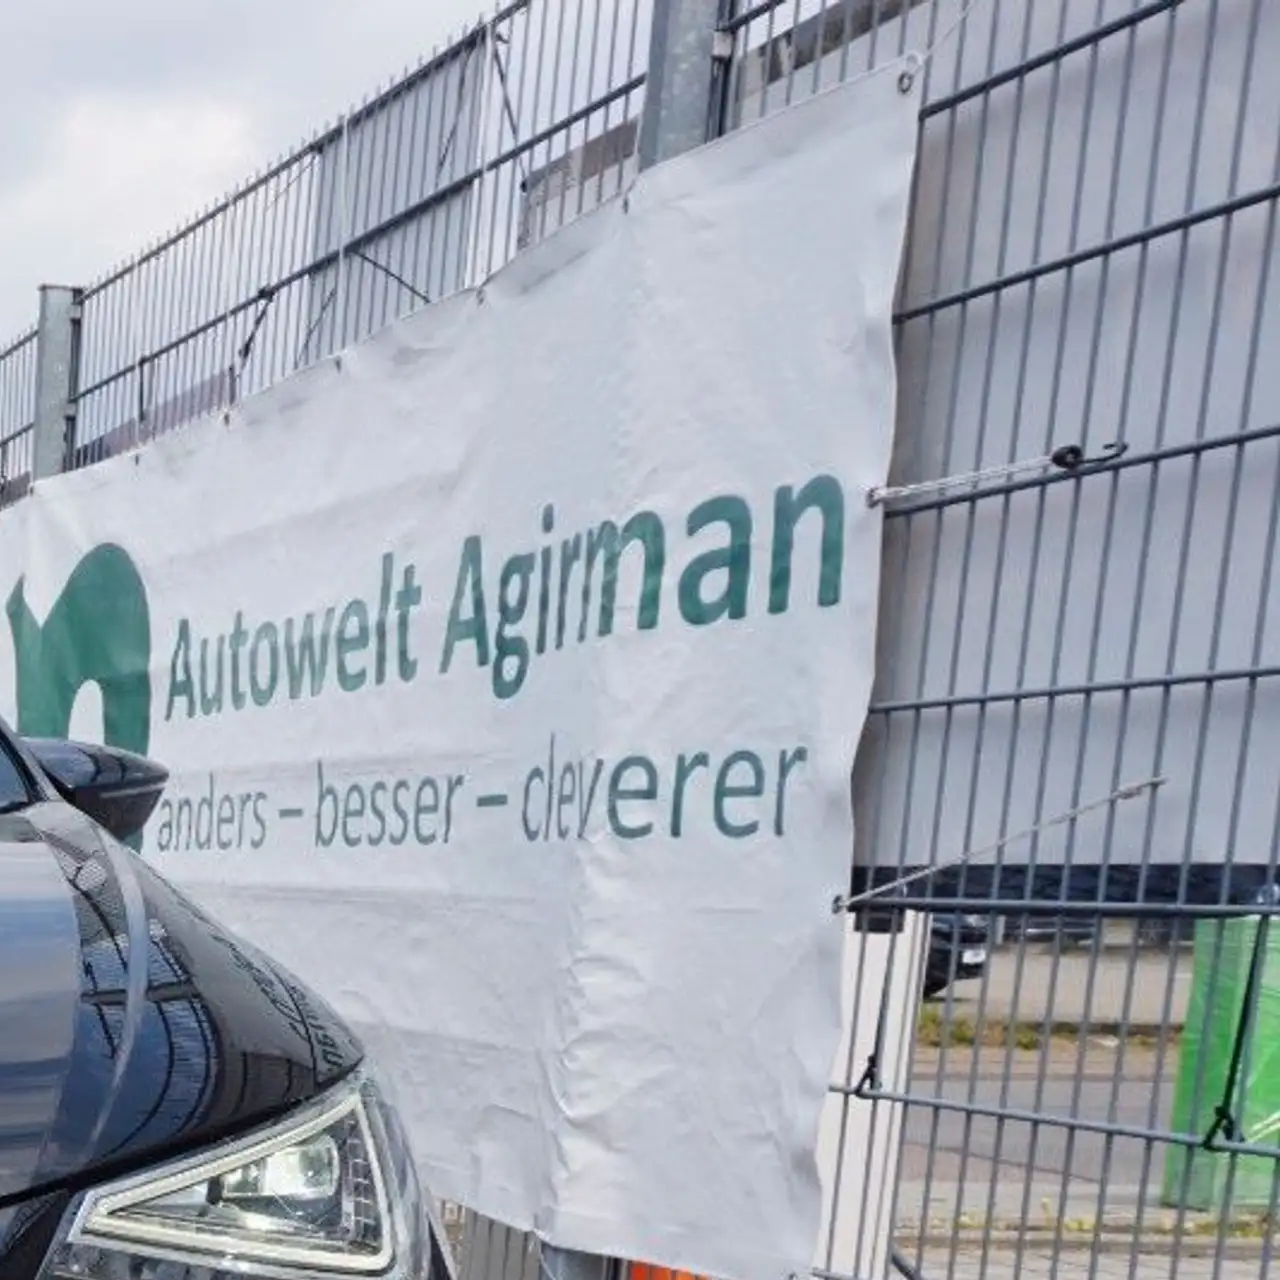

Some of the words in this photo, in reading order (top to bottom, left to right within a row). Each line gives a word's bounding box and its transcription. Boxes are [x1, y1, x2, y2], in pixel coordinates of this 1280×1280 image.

[164, 553, 422, 721] Autowelt
[439, 474, 845, 699] Agirman
[155, 772, 269, 852] anders
[314, 760, 464, 848] besser
[521, 732, 809, 843] cleverer
